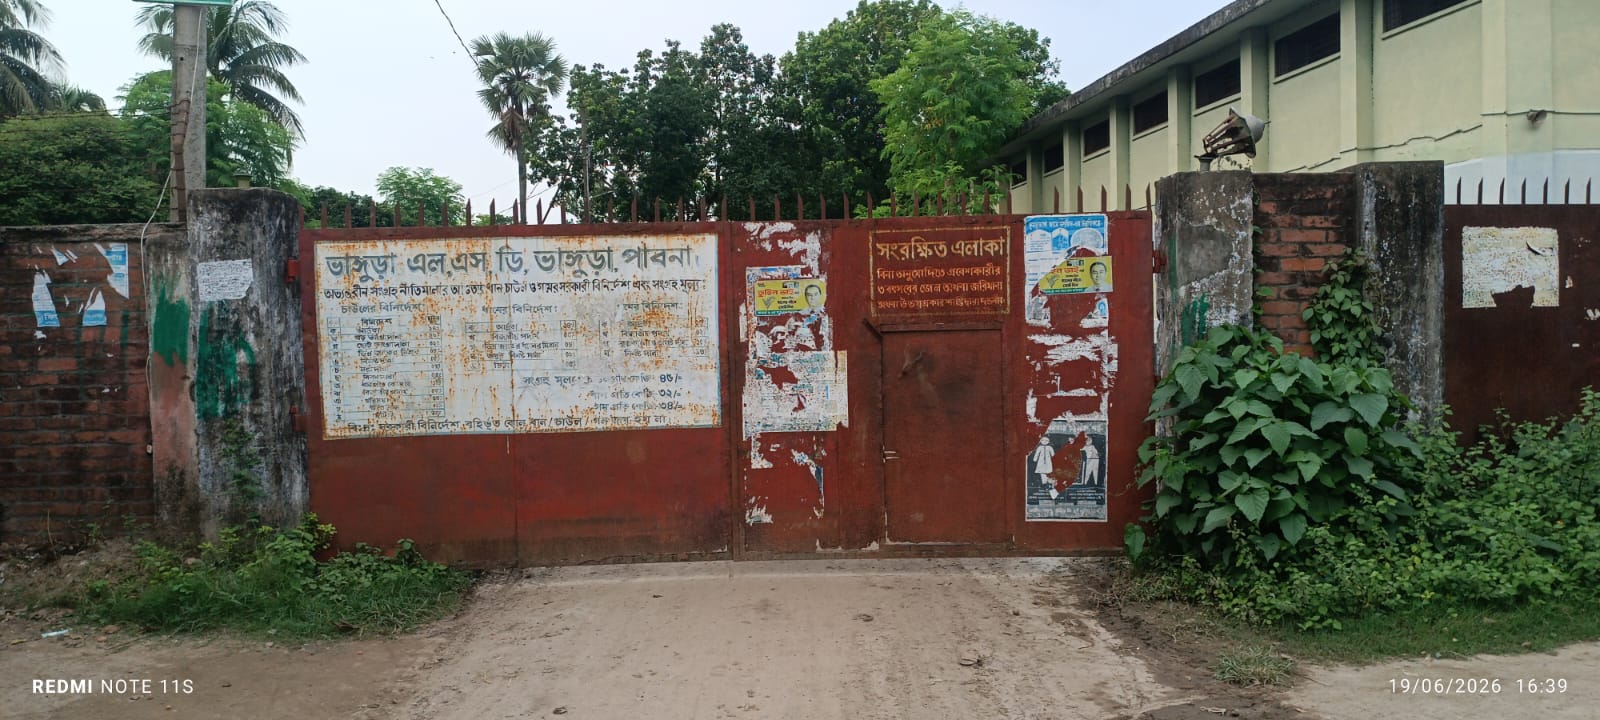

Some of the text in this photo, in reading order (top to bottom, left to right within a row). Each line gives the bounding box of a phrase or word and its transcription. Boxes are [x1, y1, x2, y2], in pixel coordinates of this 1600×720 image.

[876, 236, 947, 260] সংরক্ষিত
[951, 236, 1005, 257] এলাকা
[325, 252, 397, 283] ভাঙ্গুড়া
[877, 267, 894, 280] বিনা
[369, 285, 398, 299] সংগ্রহ
[633, 279, 651, 291] এবং
[920, 282, 941, 294] জেল
[970, 279, 1003, 292] জরিমানা
